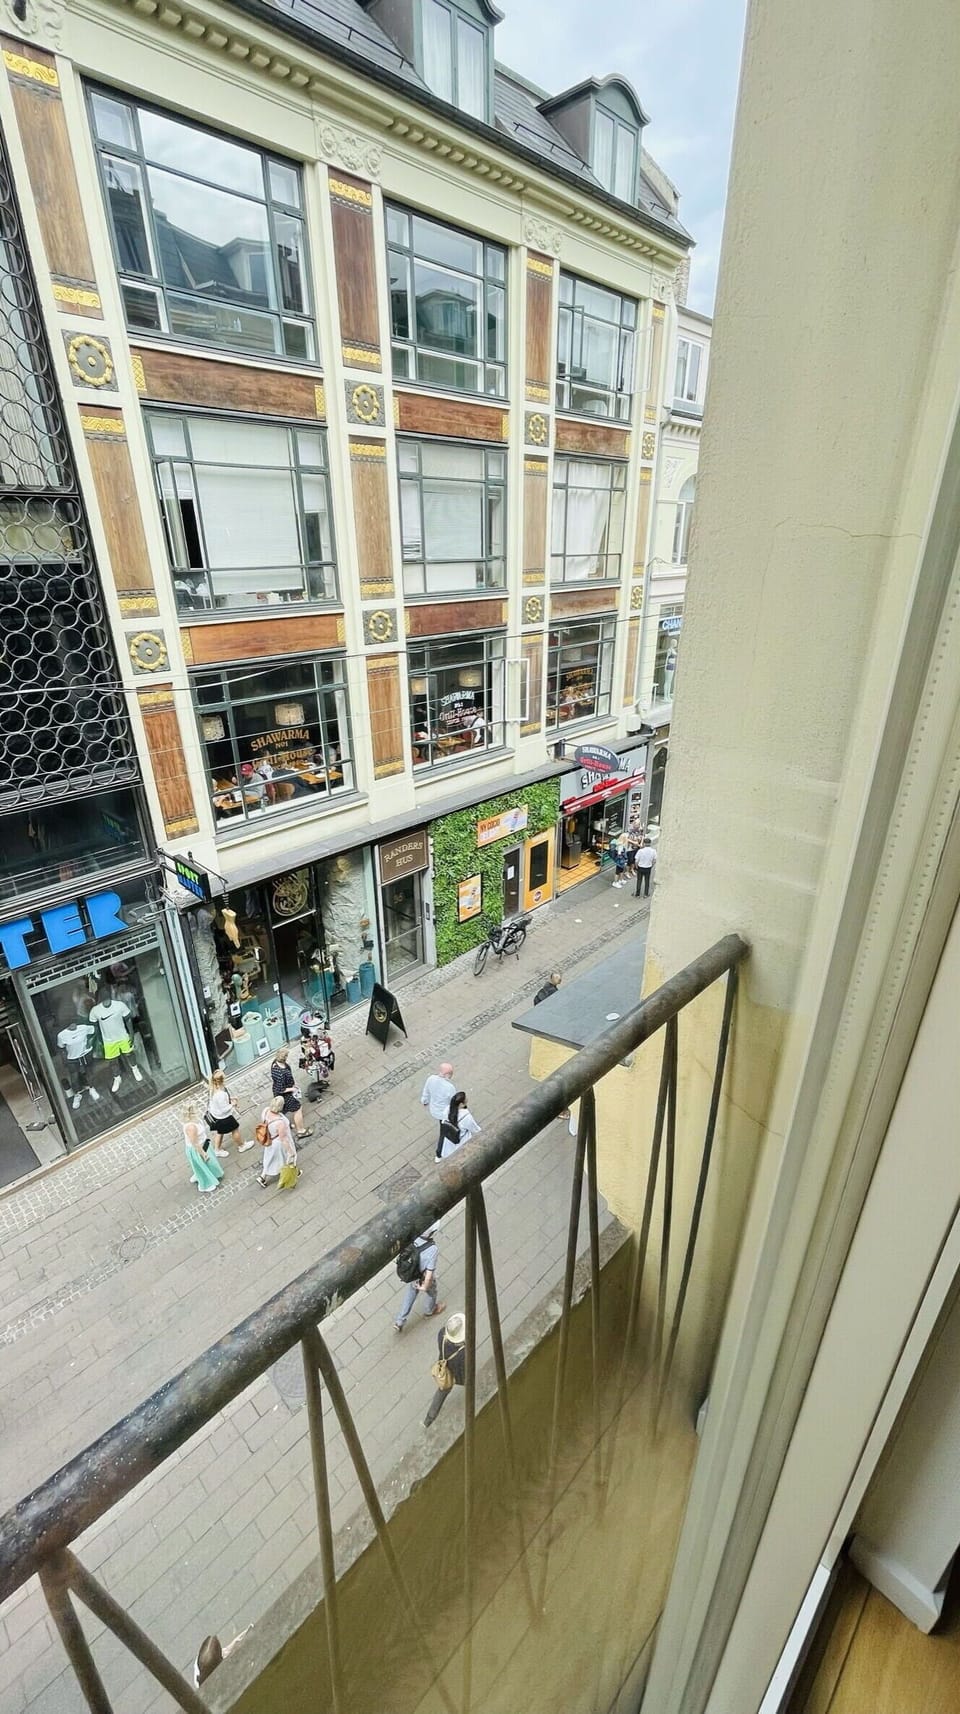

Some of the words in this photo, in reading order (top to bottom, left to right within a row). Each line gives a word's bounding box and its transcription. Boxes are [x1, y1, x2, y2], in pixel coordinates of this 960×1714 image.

[250, 729, 310, 752] SHAWARMA
[384, 842, 424, 863] RANDERS
[395, 854, 414, 867] HUS
[0, 890, 129, 970] TER
